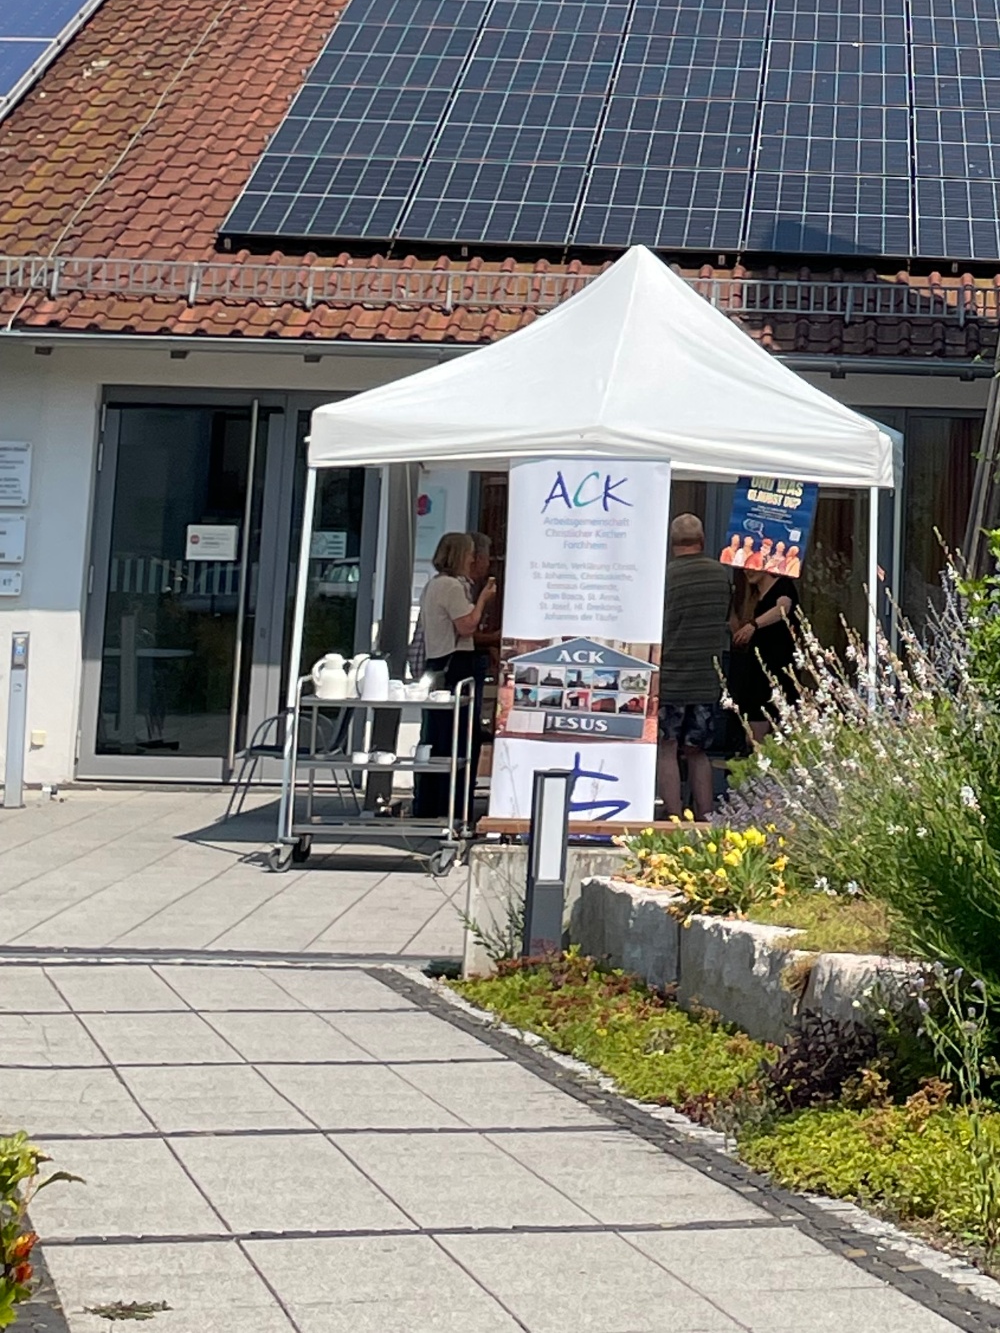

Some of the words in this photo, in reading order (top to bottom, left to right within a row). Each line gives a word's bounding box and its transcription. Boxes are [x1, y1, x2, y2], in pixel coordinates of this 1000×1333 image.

[540, 470, 634, 514] ACK
[776, 478, 804, 497] WAS
[545, 528, 593, 537] Christlicher
[595, 529, 627, 538] Kirchen
[556, 649, 605, 664] ACK
[546, 716, 608, 732] JESUS
